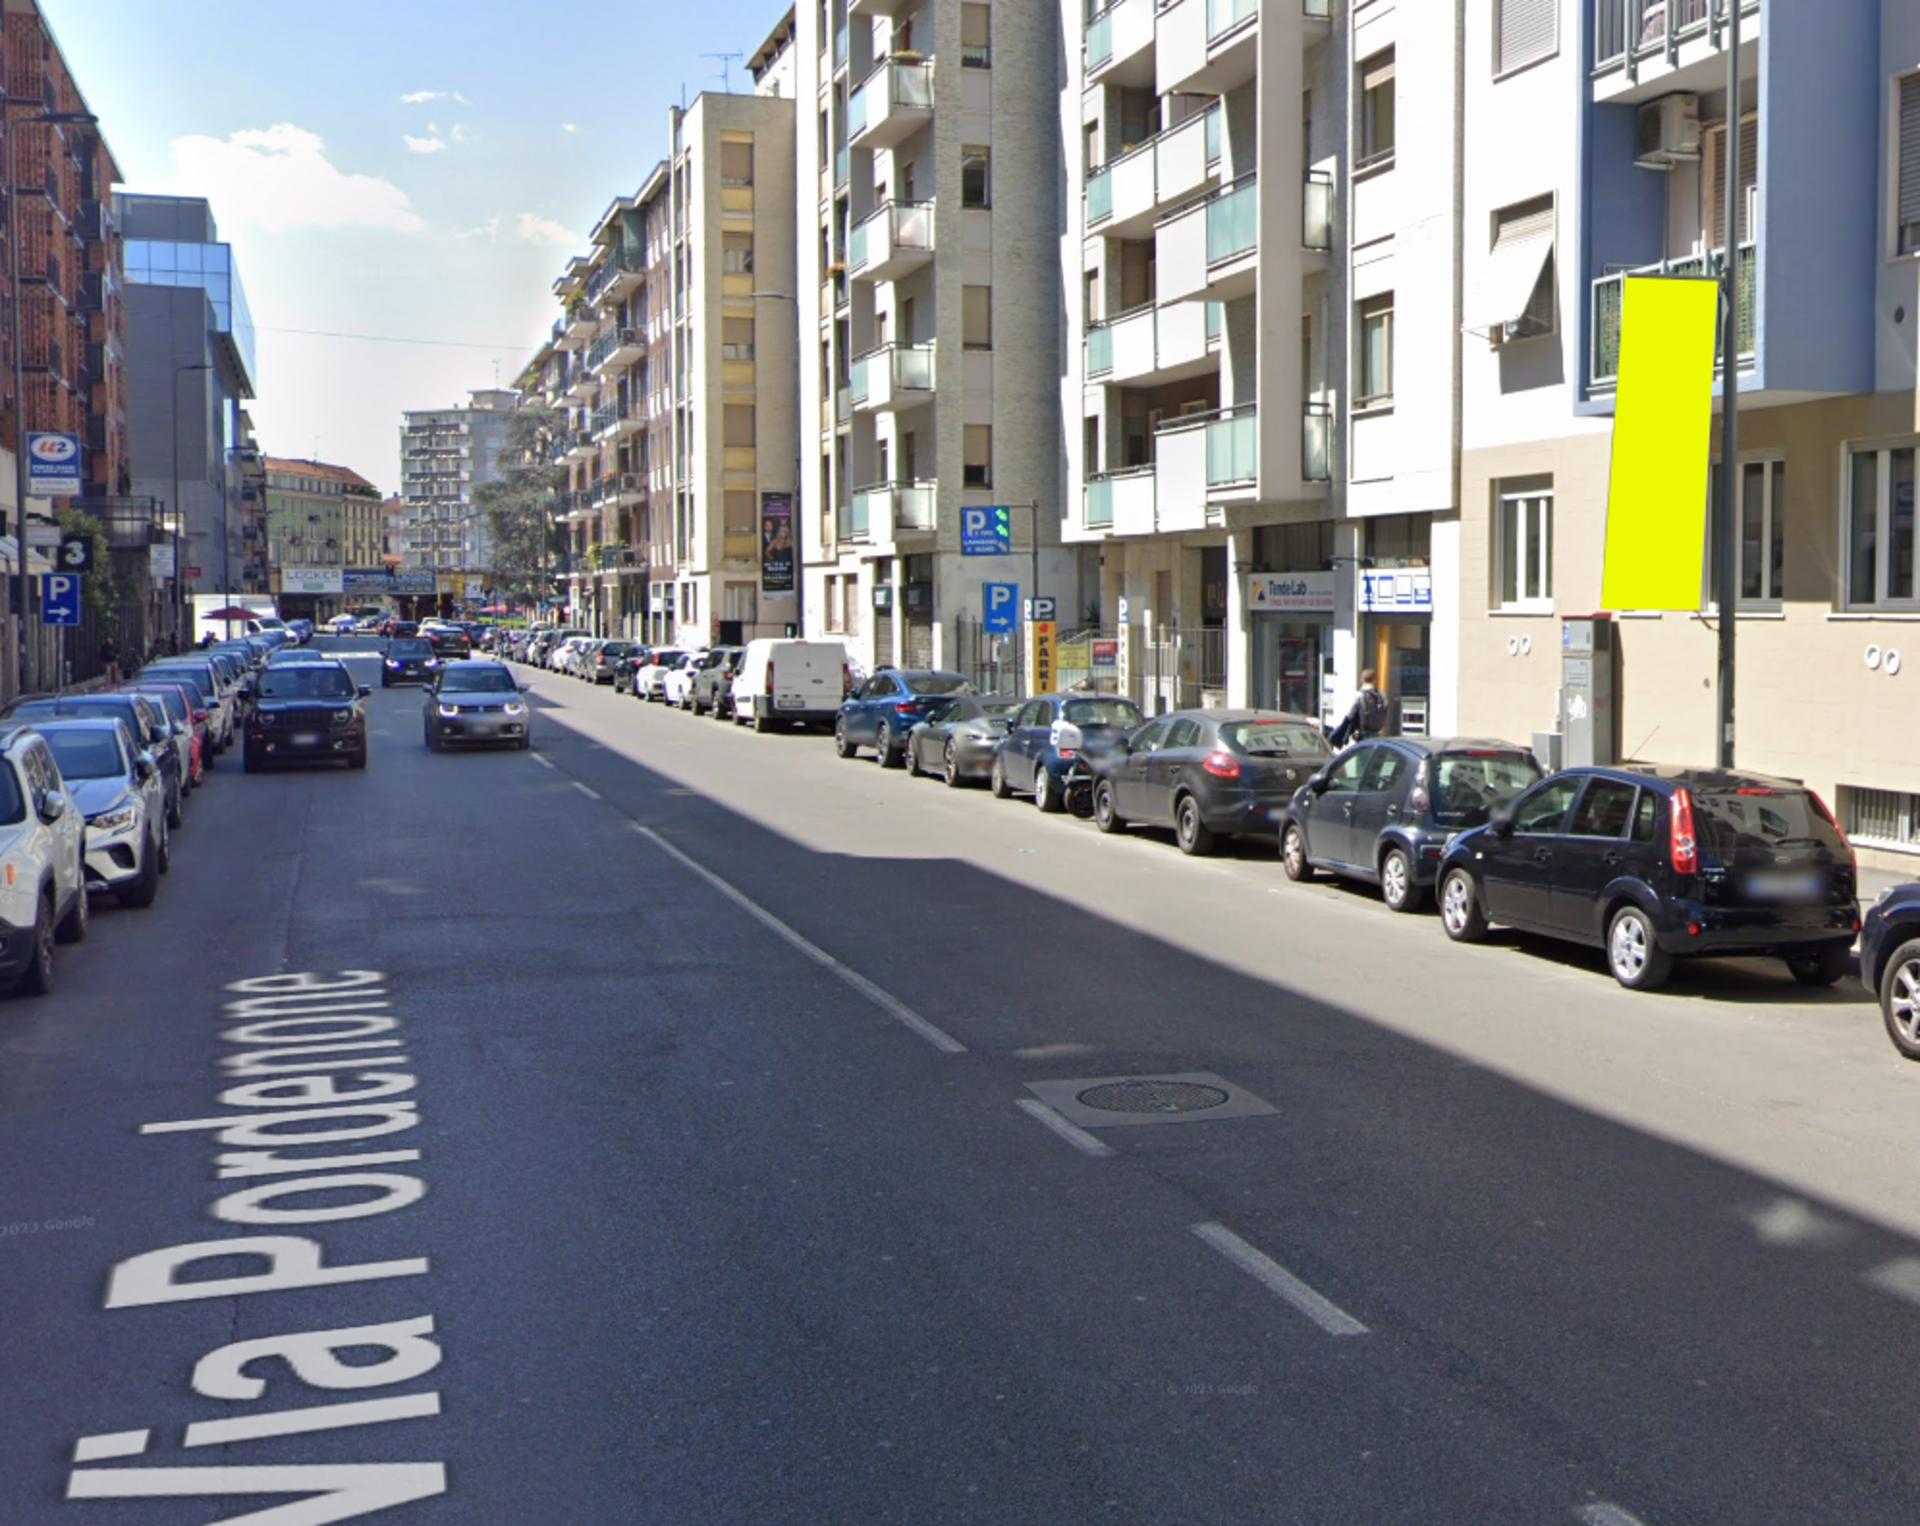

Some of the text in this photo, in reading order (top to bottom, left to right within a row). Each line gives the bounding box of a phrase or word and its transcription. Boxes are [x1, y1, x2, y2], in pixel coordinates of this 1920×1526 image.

[966, 510, 986, 537] P
[64, 541, 85, 565] 3
[285, 570, 339, 581] LOCKER
[50, 576, 70, 601] P
[990, 586, 1010, 610] P
[1034, 600, 1054, 619] P
[105, 970, 428, 1309] Pordenone
